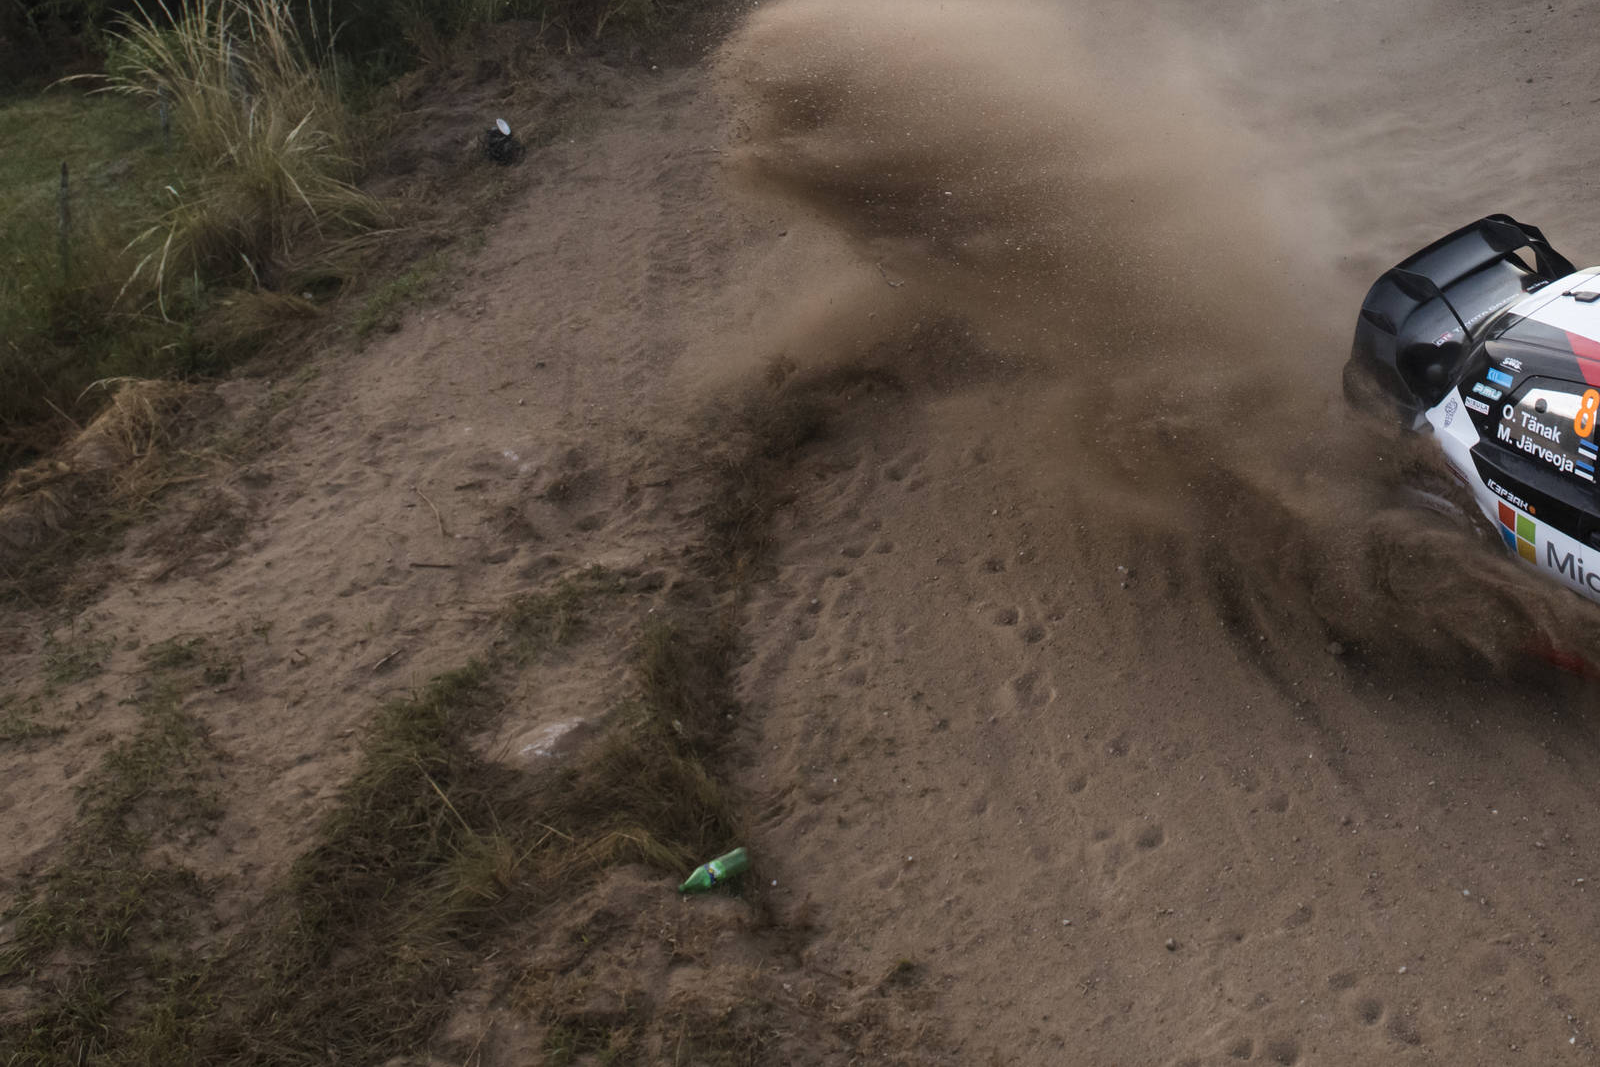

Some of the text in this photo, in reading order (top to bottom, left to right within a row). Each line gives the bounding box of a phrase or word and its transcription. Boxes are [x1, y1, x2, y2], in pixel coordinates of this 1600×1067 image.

[1502, 404, 1562, 444] O. Tänak
[1574, 388, 1600, 438] 8
[1497, 423, 1574, 473] M. Järveoja
